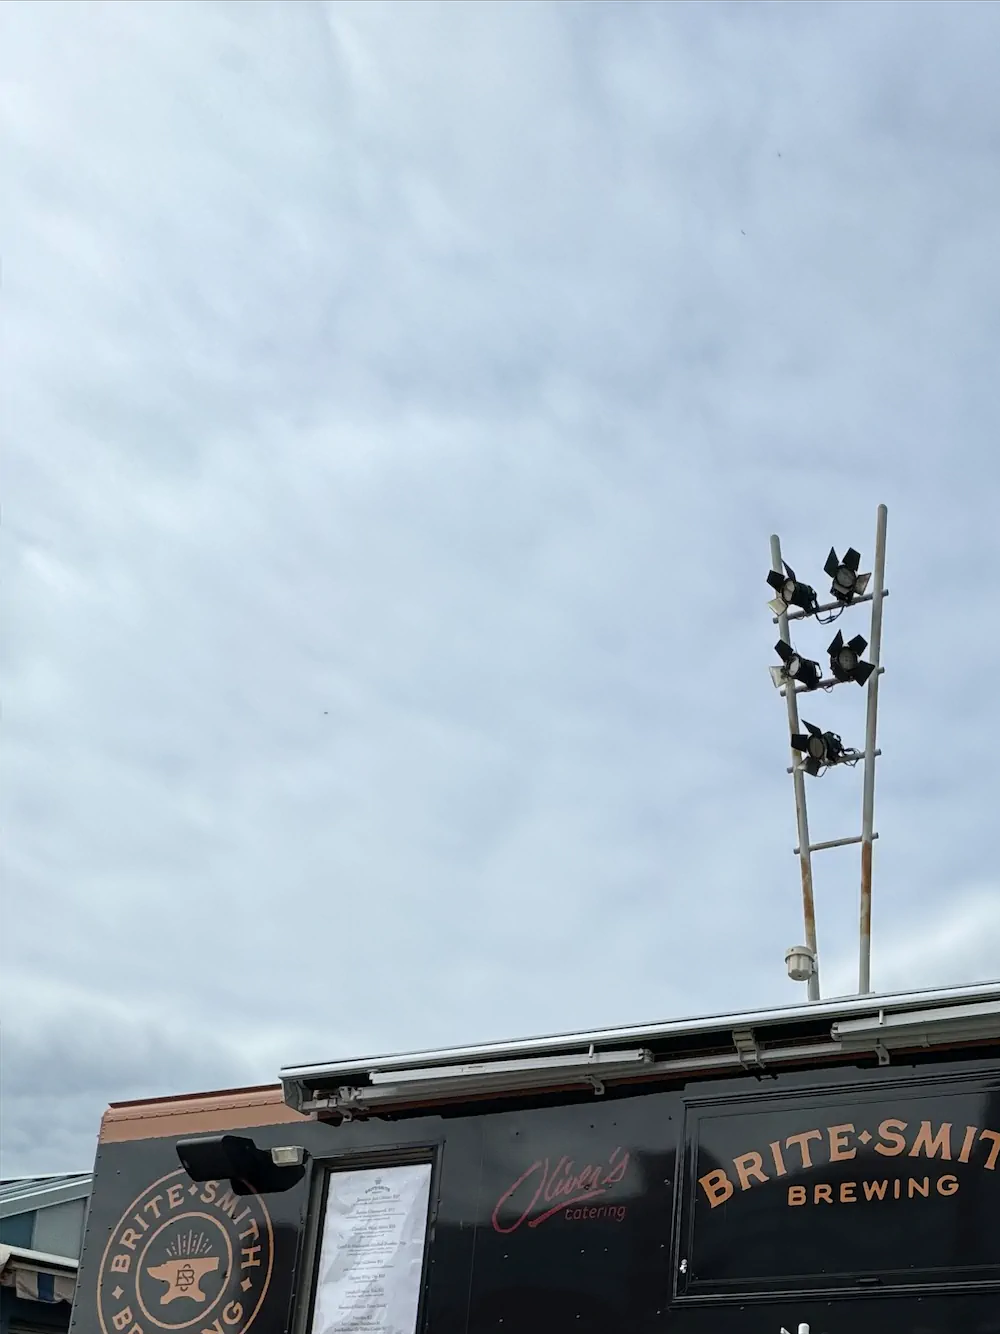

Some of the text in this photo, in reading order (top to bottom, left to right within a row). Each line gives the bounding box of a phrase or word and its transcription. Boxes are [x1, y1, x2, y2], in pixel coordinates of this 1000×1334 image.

[492, 1147, 630, 1233] Oliver's
[698, 1123, 858, 1208] BRITE
[788, 1175, 959, 1206] BREWING
[110, 1180, 262, 1273] BRITE SMITH
[565, 1206, 627, 1222] catering
